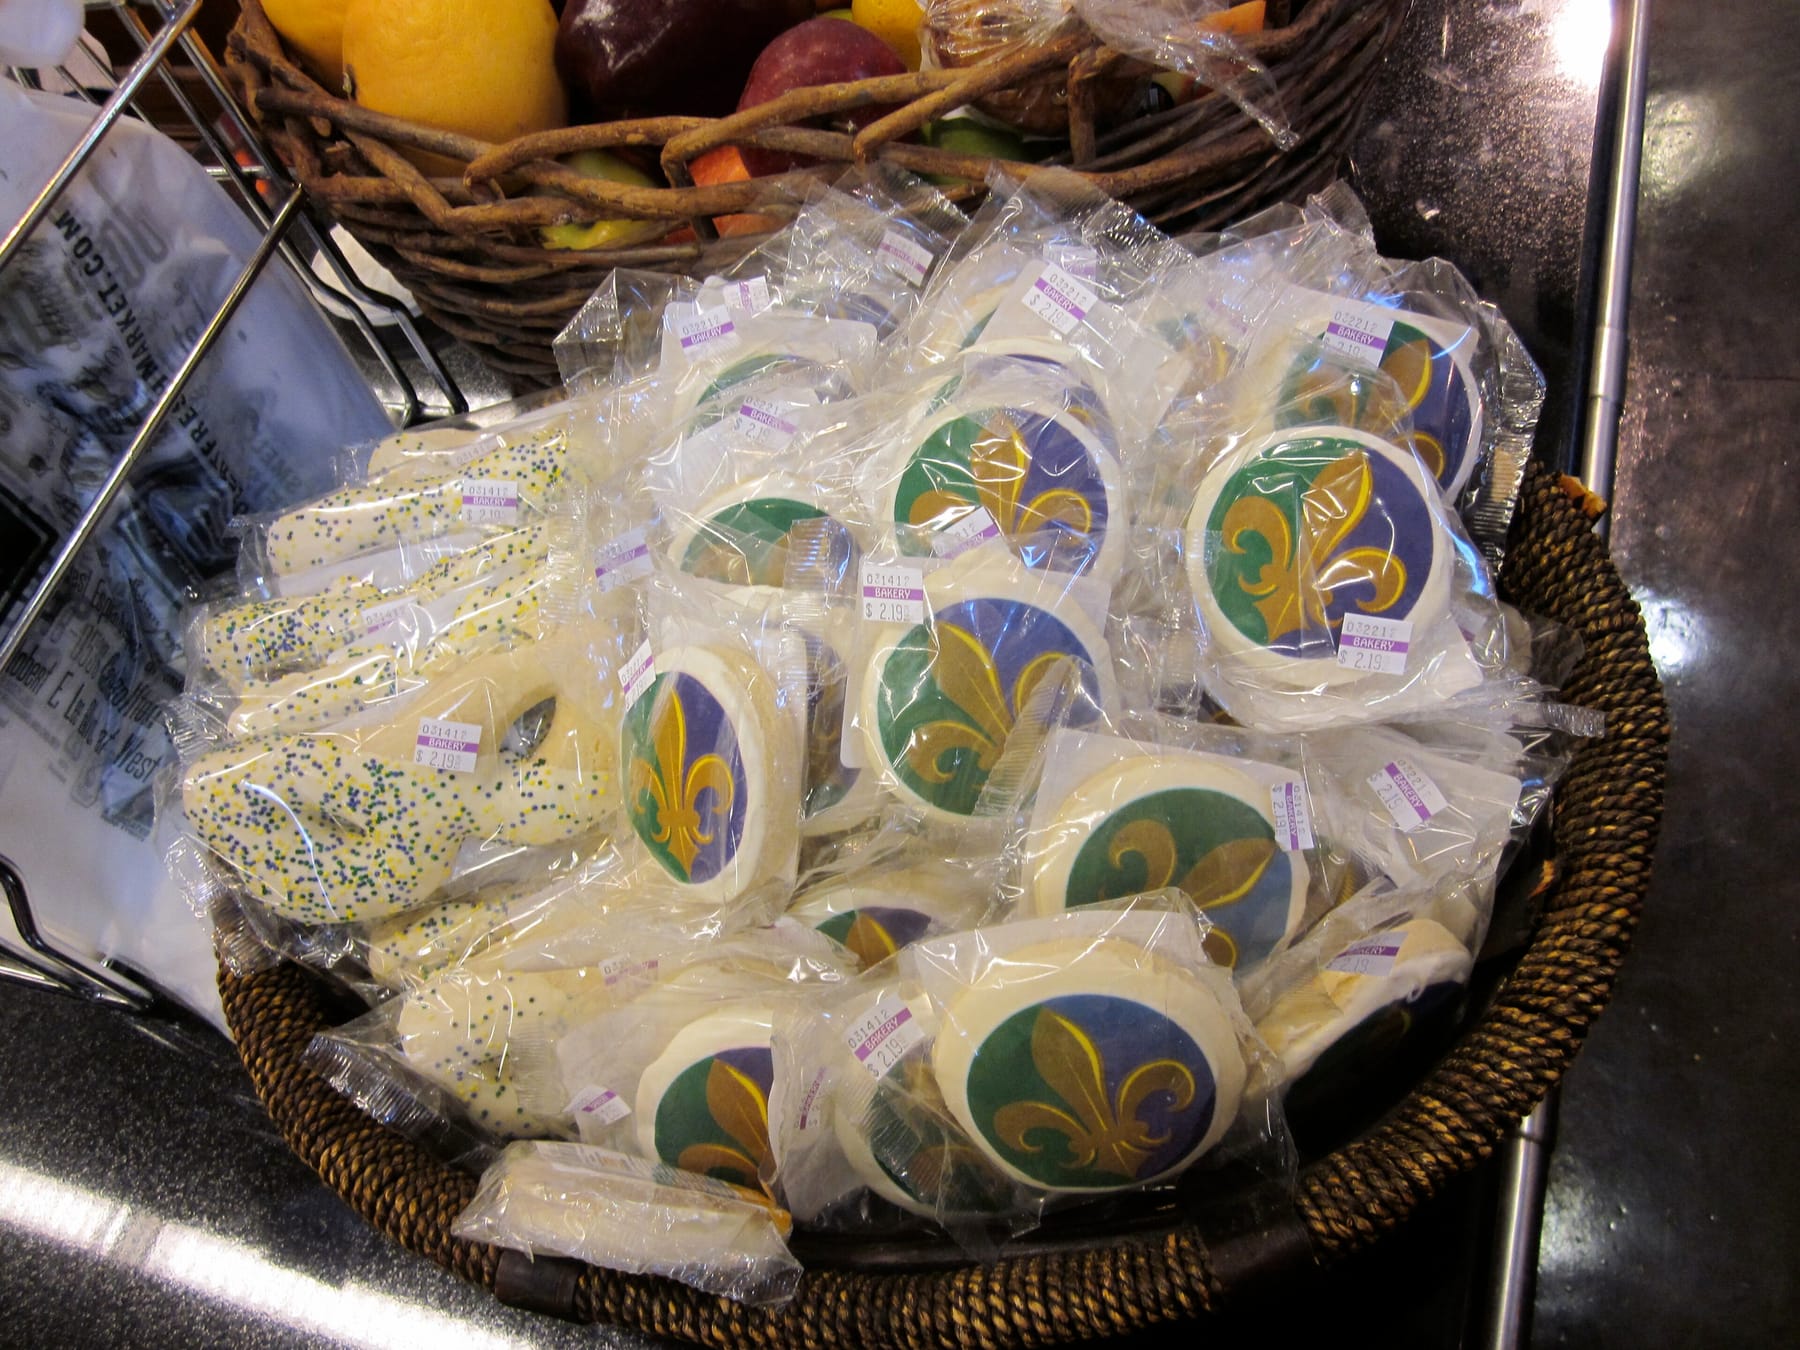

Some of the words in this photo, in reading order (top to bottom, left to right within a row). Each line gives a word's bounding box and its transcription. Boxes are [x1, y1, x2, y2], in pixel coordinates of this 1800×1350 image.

[1043, 284, 1075, 313] BAKERY
[1337, 326, 1376, 345] BAKERY
[874, 587, 911, 599] BAKERY
[865, 603, 873, 618] $
[1353, 637, 1395, 651] BAKERY
[1338, 649, 1347, 665] $
[428, 737, 466, 751] BAKERY
[112, 732, 163, 783] West
[415, 749, 423, 763] $
[1393, 774, 1424, 809] BAKERY
[1286, 795, 1297, 837] BAKERY
[847, 1009, 889, 1049] 031412
[864, 1017, 899, 1050] BAKERY
[867, 1063, 880, 1078] $
